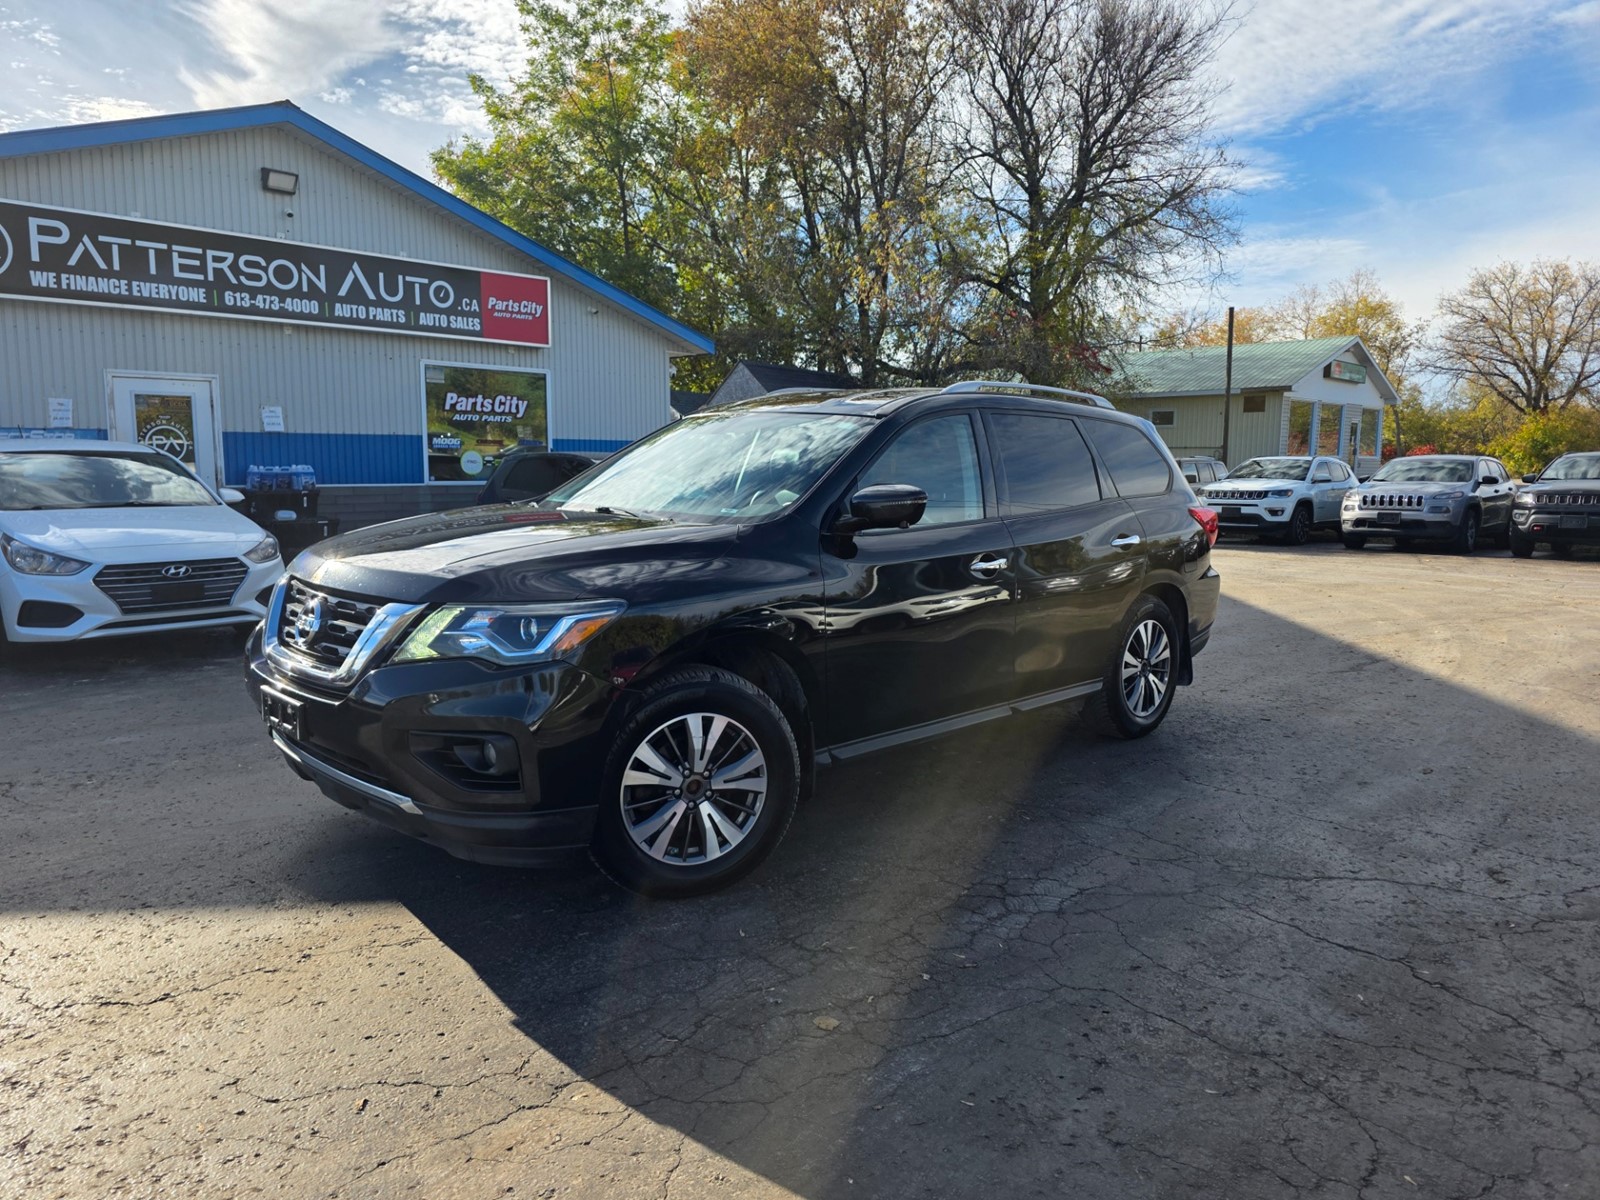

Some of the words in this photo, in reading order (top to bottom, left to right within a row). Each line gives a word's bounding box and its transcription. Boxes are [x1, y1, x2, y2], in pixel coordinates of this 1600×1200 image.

[28, 216, 326, 294] PATTERSON
[29, 270, 57, 289] WE
[61, 273, 129, 295] FINANCE
[132, 281, 207, 303] EVERYONE
[224, 291, 319, 314] 613-473-4000
[334, 303, 367, 320] AUTO
[369, 306, 406, 324] PARTS
[419, 312, 448, 328] AUTO
[450, 315, 481, 331] SALES
[487, 296, 543, 318] PartsCity
[444, 392, 528, 418] PartsCity
[453, 413, 480, 421] AUTO
[481, 414, 513, 422] PARTS
[432, 437, 461, 445] MOOG
